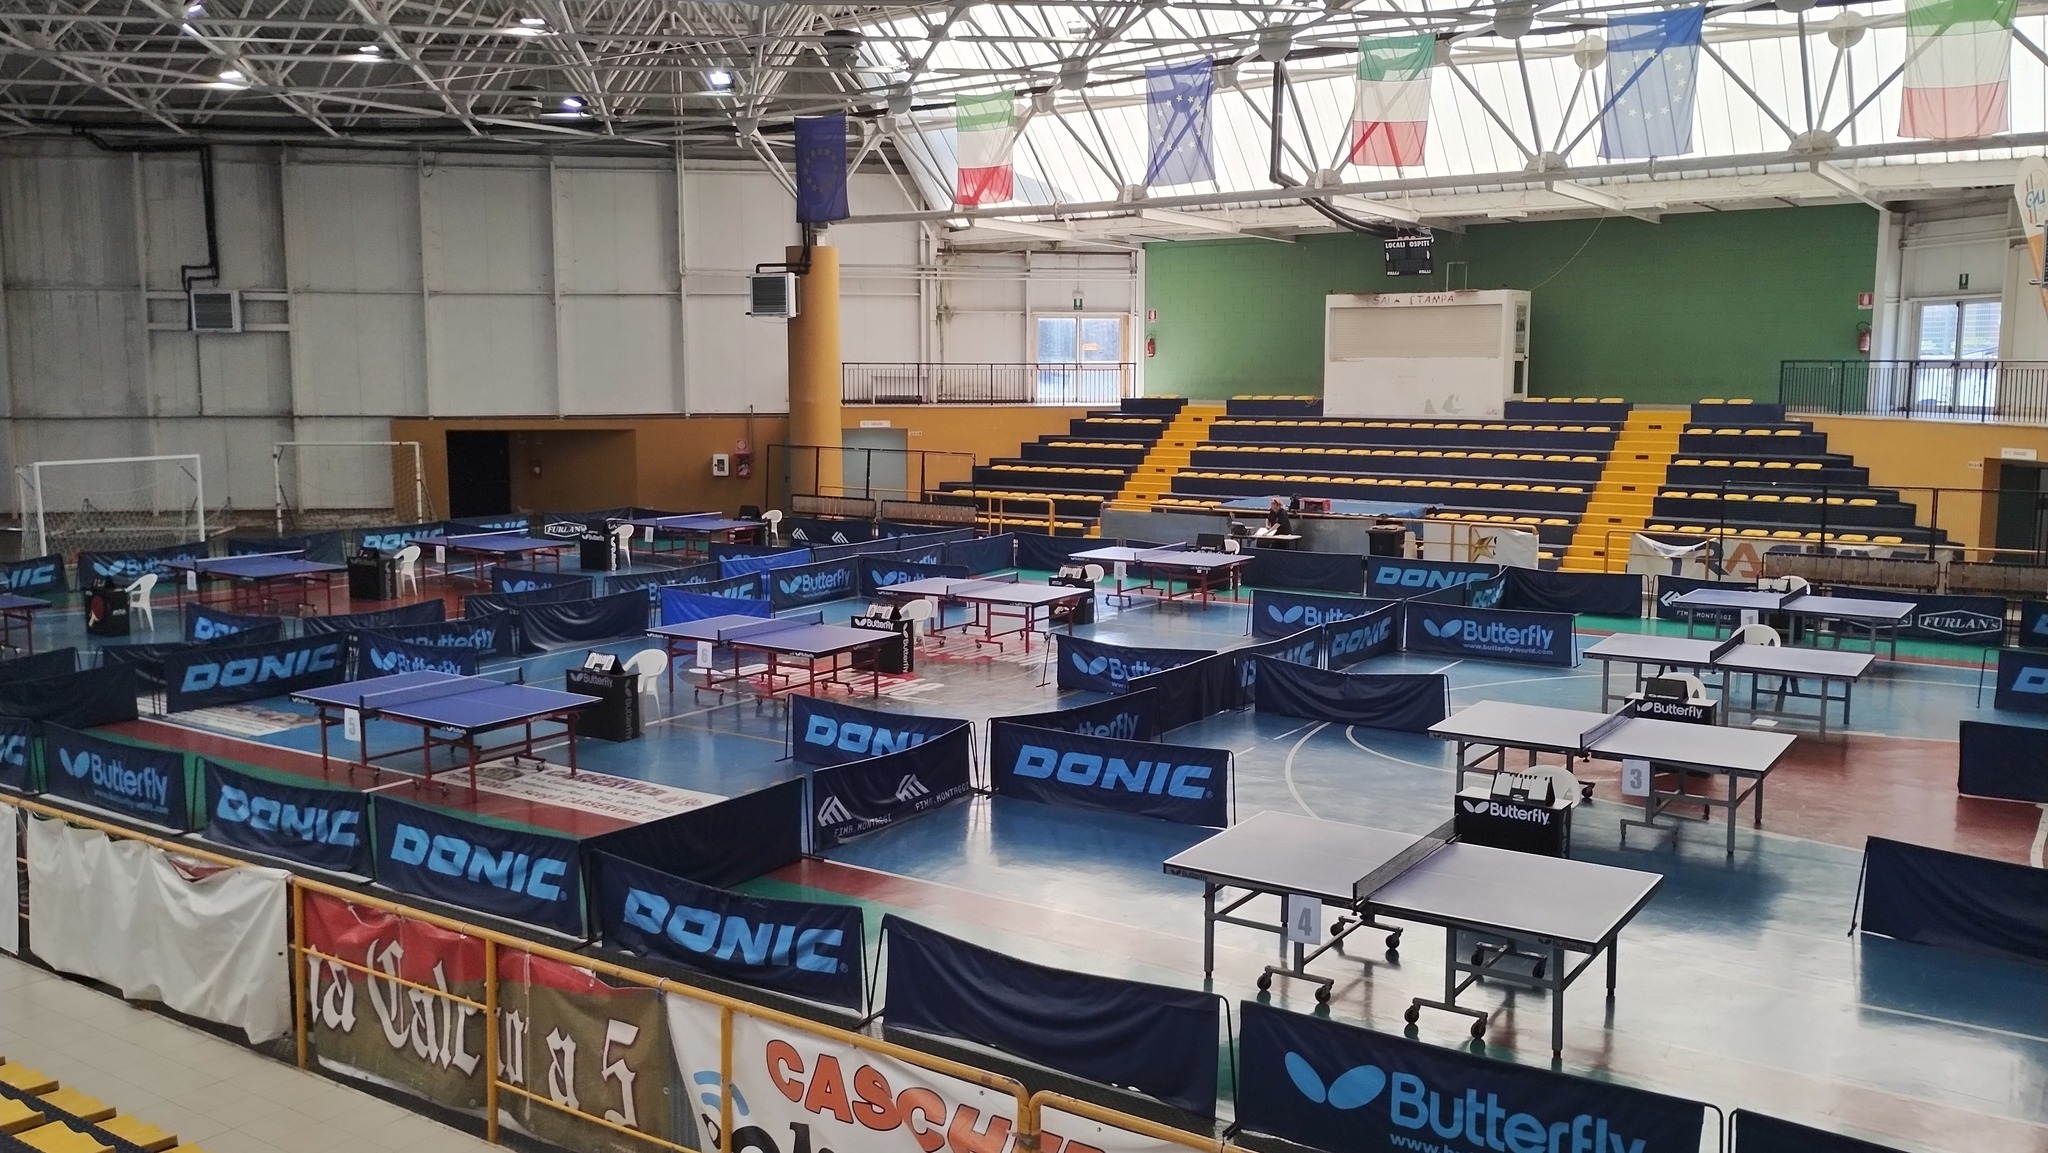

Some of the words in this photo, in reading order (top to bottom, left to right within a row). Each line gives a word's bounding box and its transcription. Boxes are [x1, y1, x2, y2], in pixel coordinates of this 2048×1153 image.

[1385, 241, 1406, 249] LOCALI
[1409, 240, 1430, 248] OSPITI
[802, 568, 851, 592] Butterfly
[866, 618, 894, 631] Butterfly
[1331, 616, 1392, 658] DONIC
[1463, 620, 1554, 650] Butterfly
[181, 643, 341, 693] DONIC
[582, 673, 613, 688] Butterfly
[1653, 701, 1703, 719] Butterfly
[805, 714, 942, 757] DONI
[90, 752, 169, 806] Butterfly
[1013, 744, 1213, 800] DONIC
[1629, 767, 1643, 790] 3
[217, 784, 360, 847] DONIC
[1489, 801, 1550, 826] Butterfly
[391, 823, 568, 901] DONIC
[624, 887, 844, 974] DONIC
[1297, 907, 1313, 937] 4
[602, 1018, 640, 1128] 5
